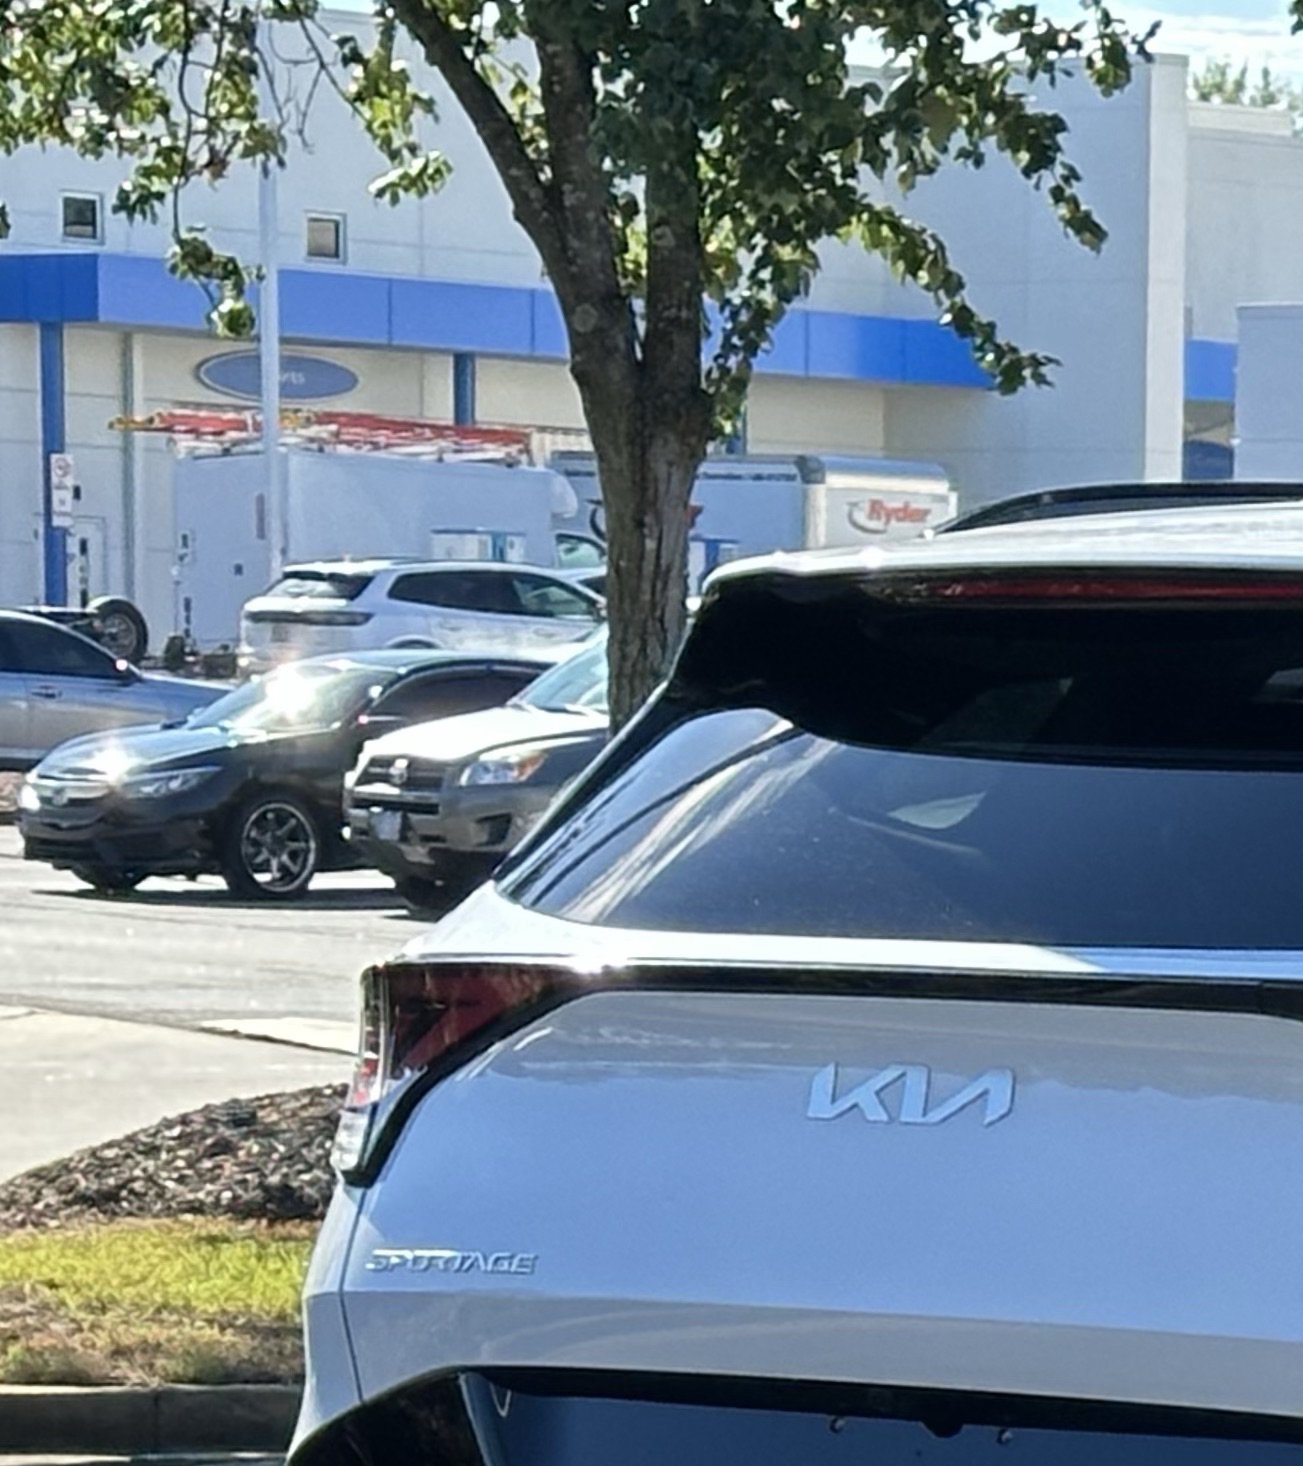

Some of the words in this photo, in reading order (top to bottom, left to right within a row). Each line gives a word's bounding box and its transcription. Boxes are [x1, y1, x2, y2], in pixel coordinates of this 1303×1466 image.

[866, 499, 931, 527] Ryder
[807, 1061, 1016, 1128] KIA
[365, 1250, 537, 1275] SPORTAGE
